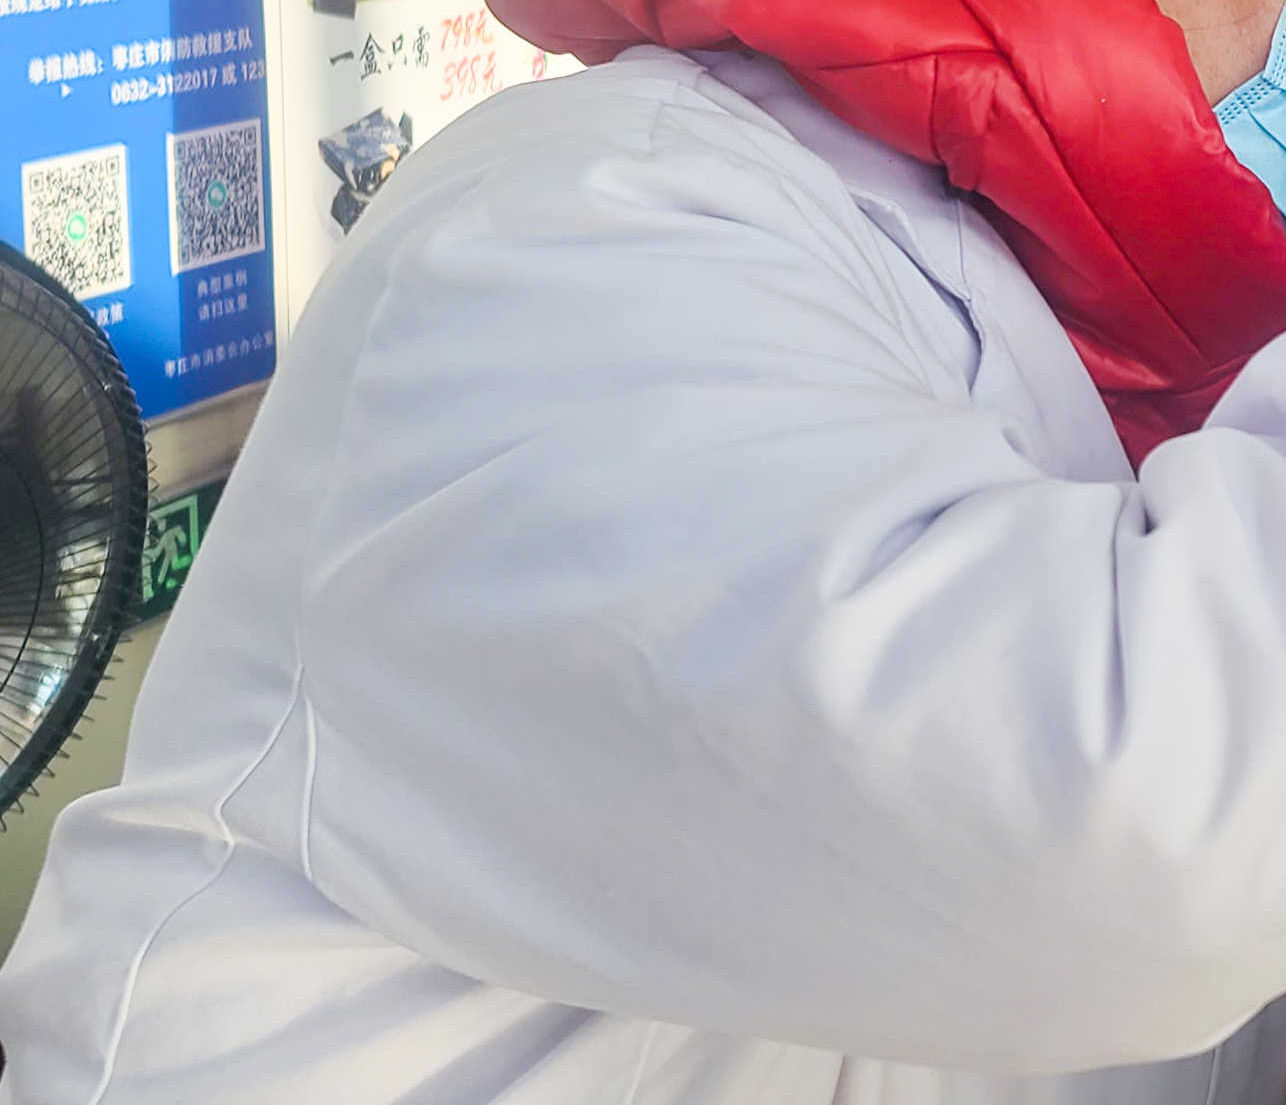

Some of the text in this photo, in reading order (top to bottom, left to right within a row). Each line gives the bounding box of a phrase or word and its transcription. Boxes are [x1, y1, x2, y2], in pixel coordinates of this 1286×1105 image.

[329, 25, 431, 82] 一盒只需
[110, 67, 218, 107] 0632-3122017
